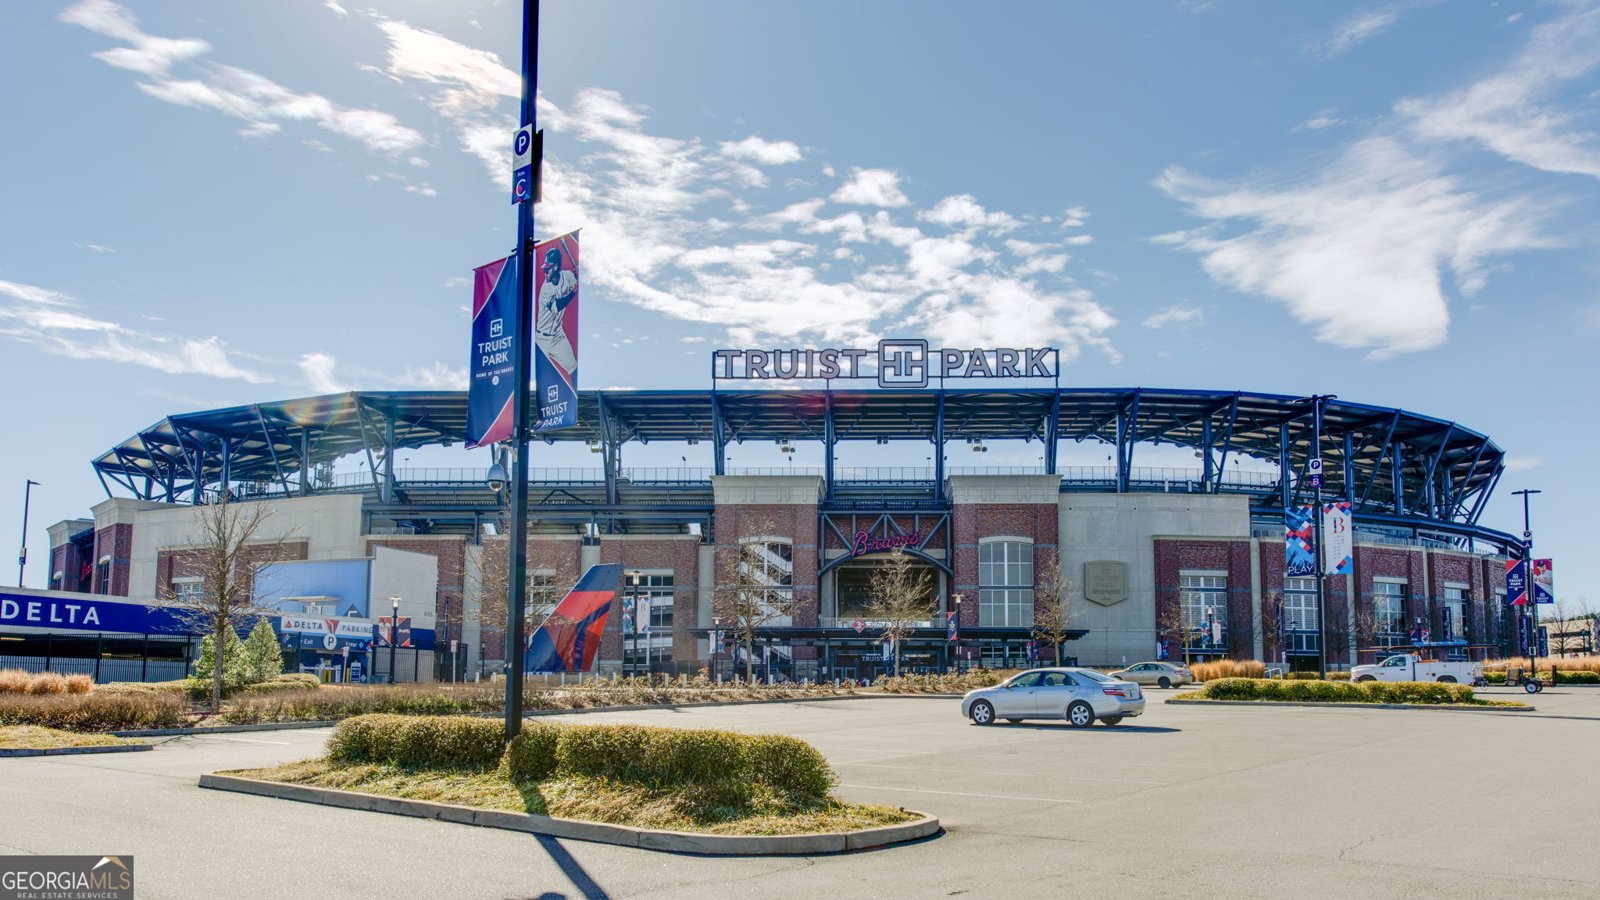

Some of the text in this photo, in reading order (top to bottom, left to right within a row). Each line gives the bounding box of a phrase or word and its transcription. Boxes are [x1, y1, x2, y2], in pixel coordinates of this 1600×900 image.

[518, 135, 527, 152] P
[516, 178, 526, 197] C
[478, 336, 513, 354] TRUIST
[482, 351, 509, 367] PARK
[717, 347, 1053, 379] TRUIST PARK
[540, 401, 568, 418] TRUIST
[541, 414, 565, 428] PARK
[1331, 516, 1345, 534] B
[851, 531, 919, 557] Braves
[1287, 565, 1314, 574] PLAY
[0, 599, 100, 625] DELTA
[294, 620, 323, 630] DELTA
[327, 636, 335, 646] P
